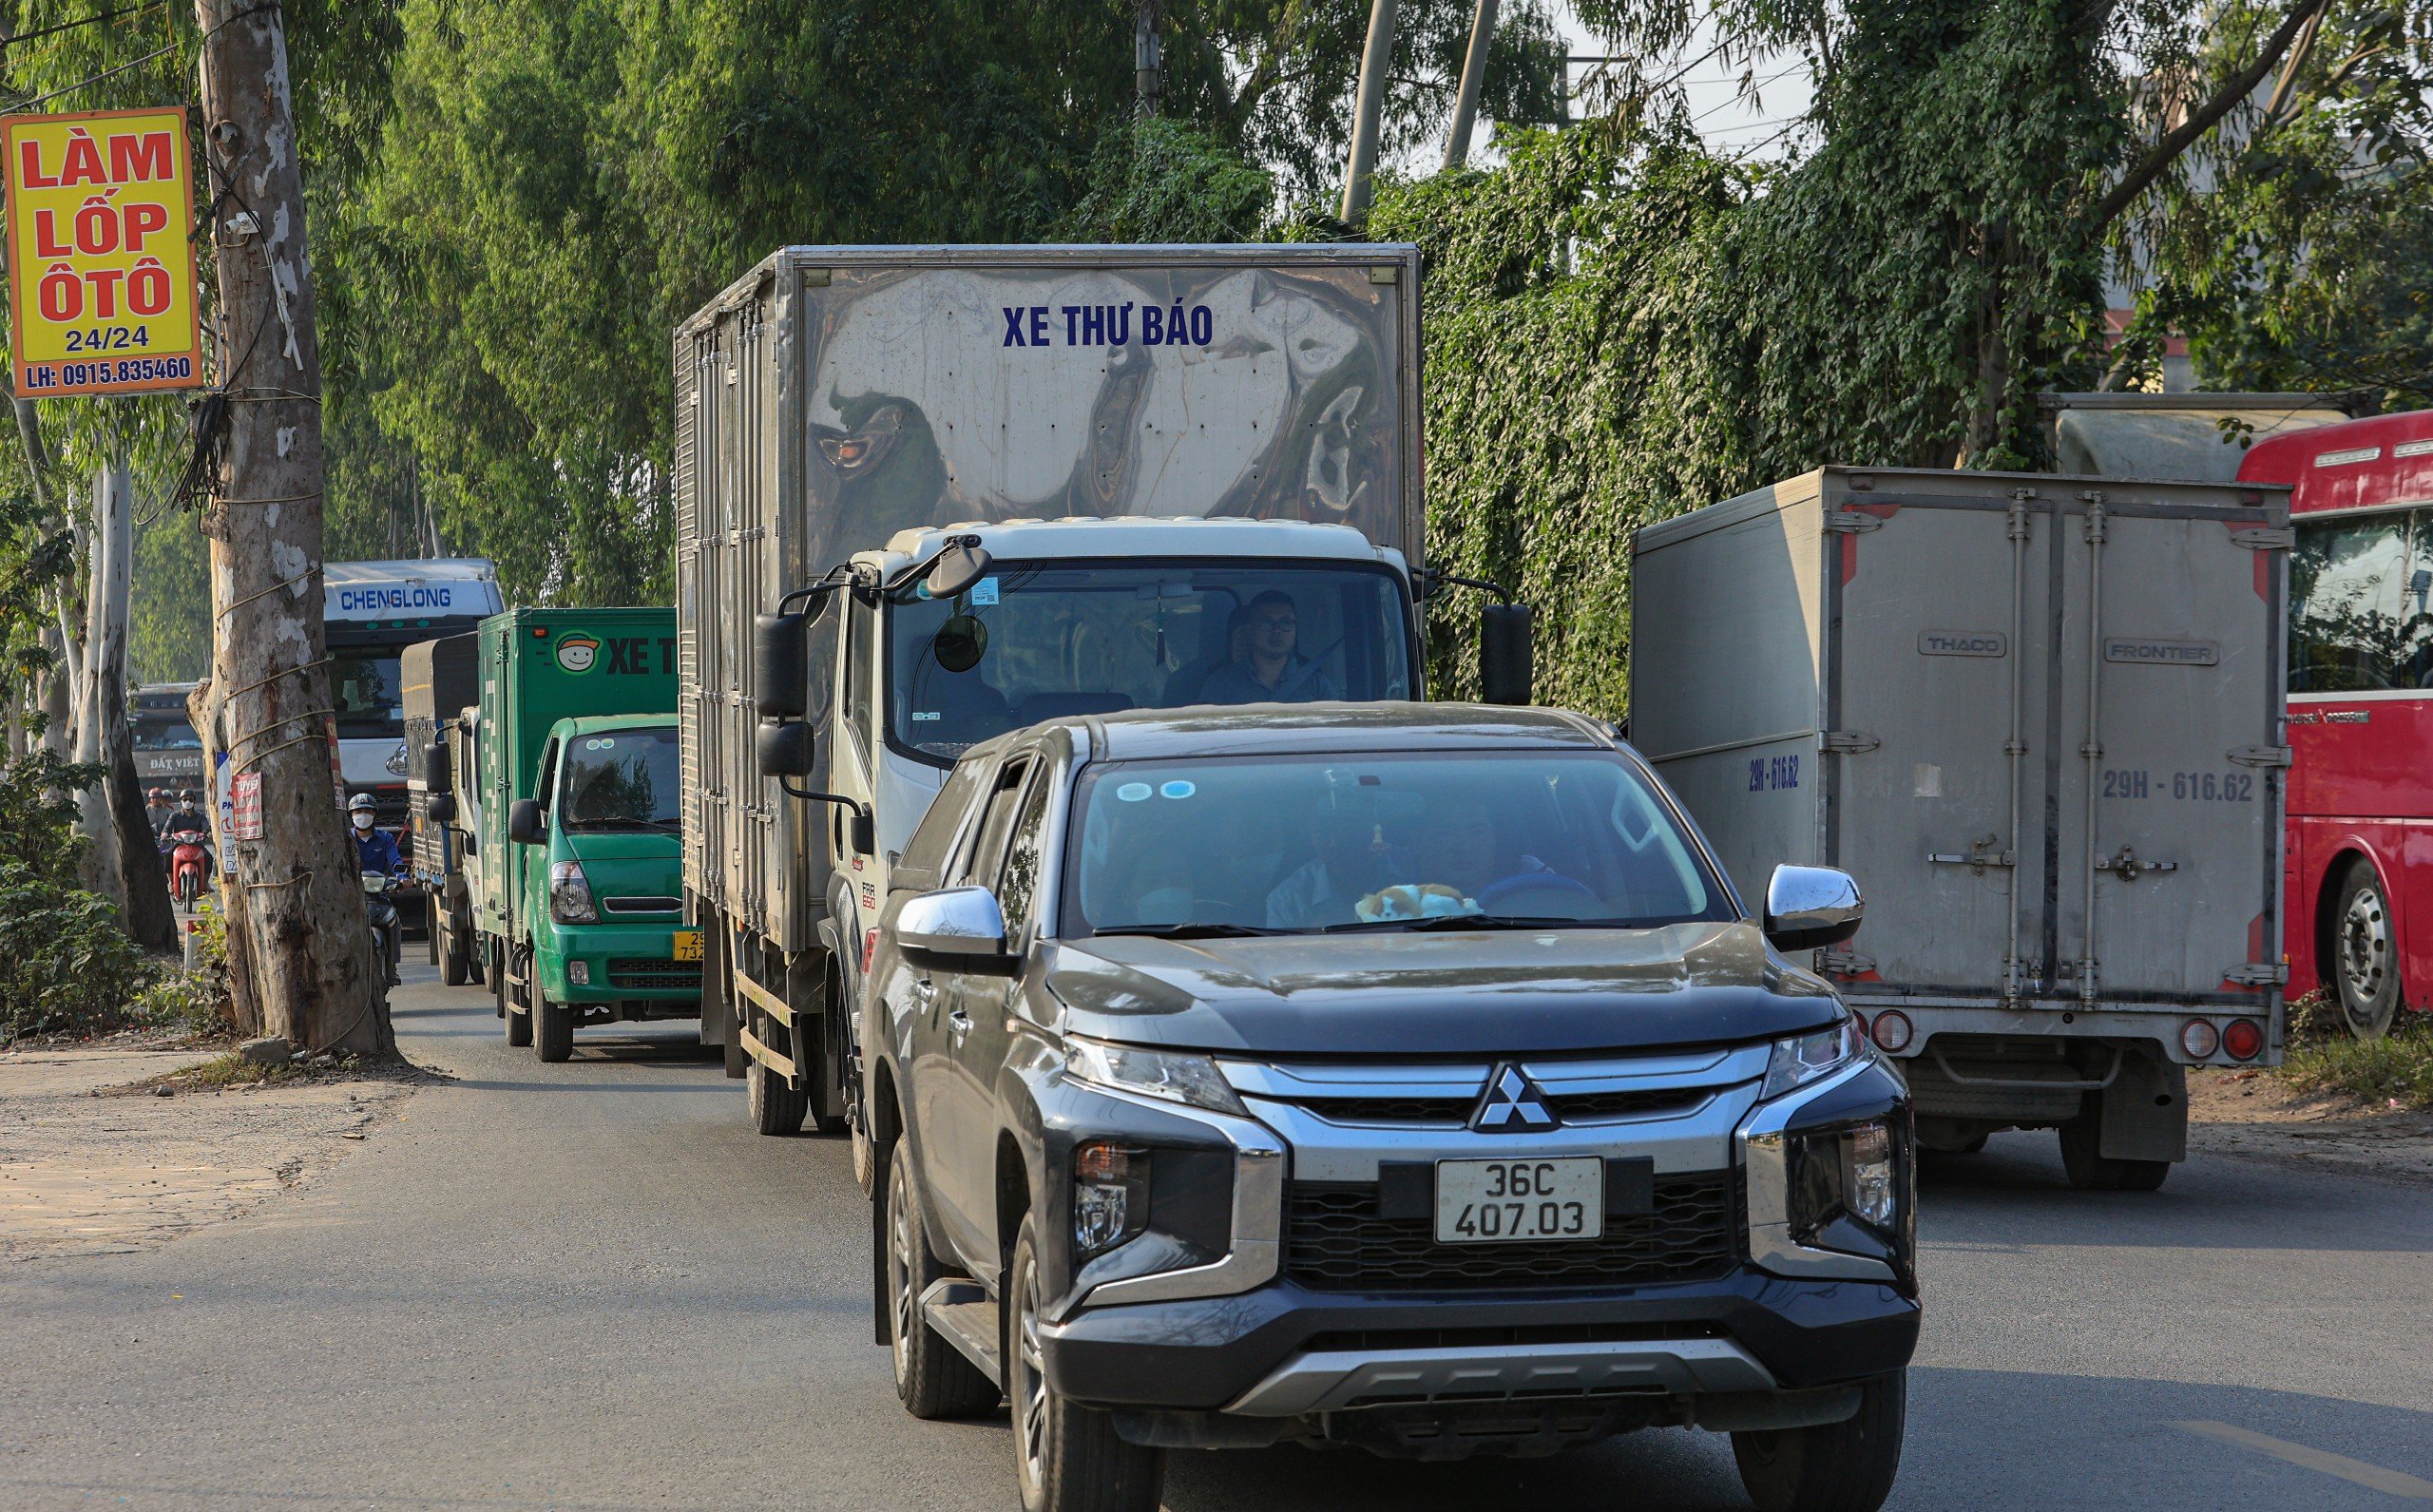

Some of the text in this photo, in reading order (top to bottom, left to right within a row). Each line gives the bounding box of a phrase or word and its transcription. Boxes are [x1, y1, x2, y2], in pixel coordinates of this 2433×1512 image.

[21, 126, 175, 188] LÀM
[35, 188, 168, 258] LỐP
[39, 257, 171, 321] ÔTÔ
[66, 326, 149, 352] 24/24
[1003, 297, 1213, 347] XE THƯ BÁO
[26, 356, 191, 389] LH: 0915.835460
[341, 588, 451, 610] CHENGLONG
[606, 638, 648, 675] XE
[1927, 637, 2000, 652] THACO
[2110, 643, 2213, 660] FRONTIER
[1750, 757, 1765, 792] 29H
[1772, 755, 1799, 790] 616.62
[2103, 770, 2149, 799] 29H
[2173, 772, 2252, 802] 616.62
[1485, 1163, 1555, 1197] 36C
[1455, 1201, 1584, 1236] 407.03
